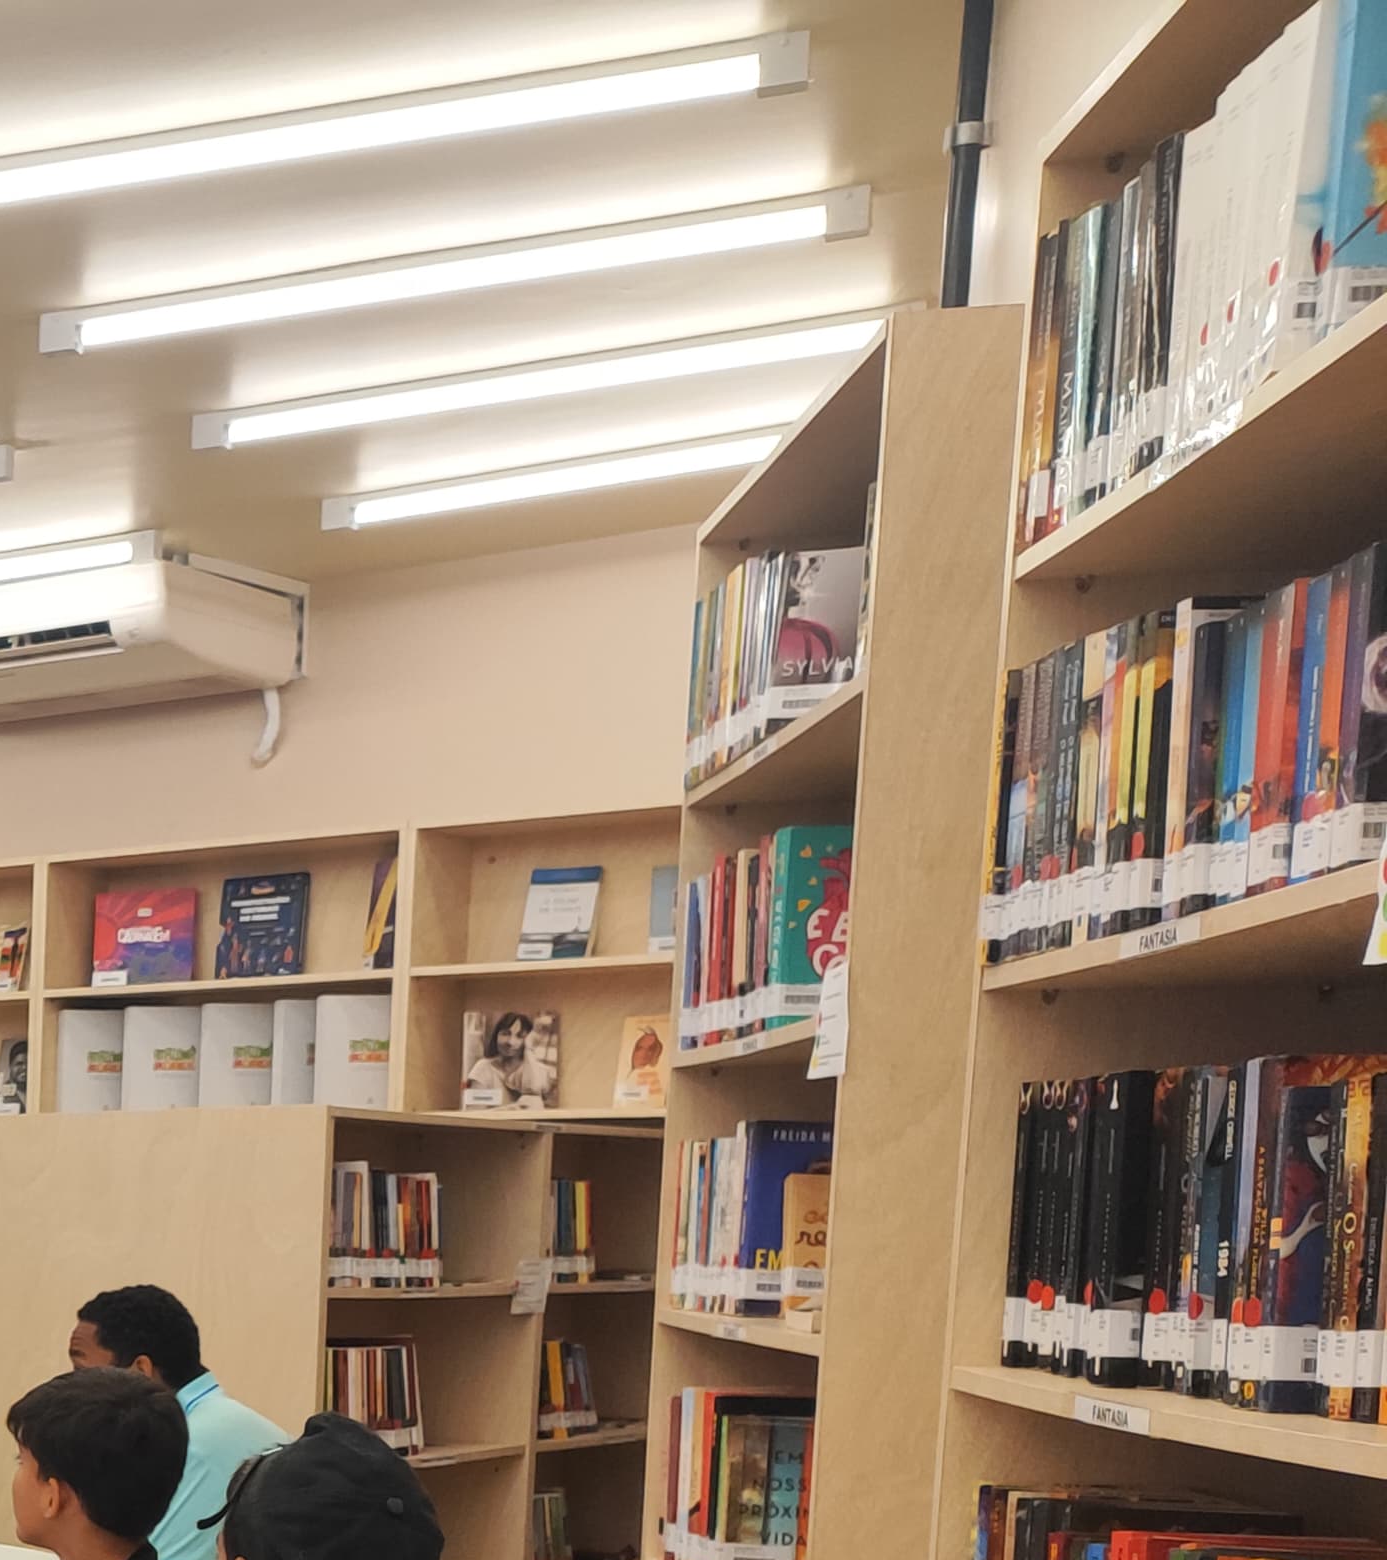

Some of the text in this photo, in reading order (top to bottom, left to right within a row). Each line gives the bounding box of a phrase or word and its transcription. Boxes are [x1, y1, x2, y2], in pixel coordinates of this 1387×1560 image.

[782, 657, 854, 678] SYLVIA
[1139, 927, 1178, 951] FANTASIA
[772, 1129, 816, 1142] FREIDA
[1217, 1239, 1230, 1278] 1984
[1091, 1403, 1129, 1429] FANTASIA
